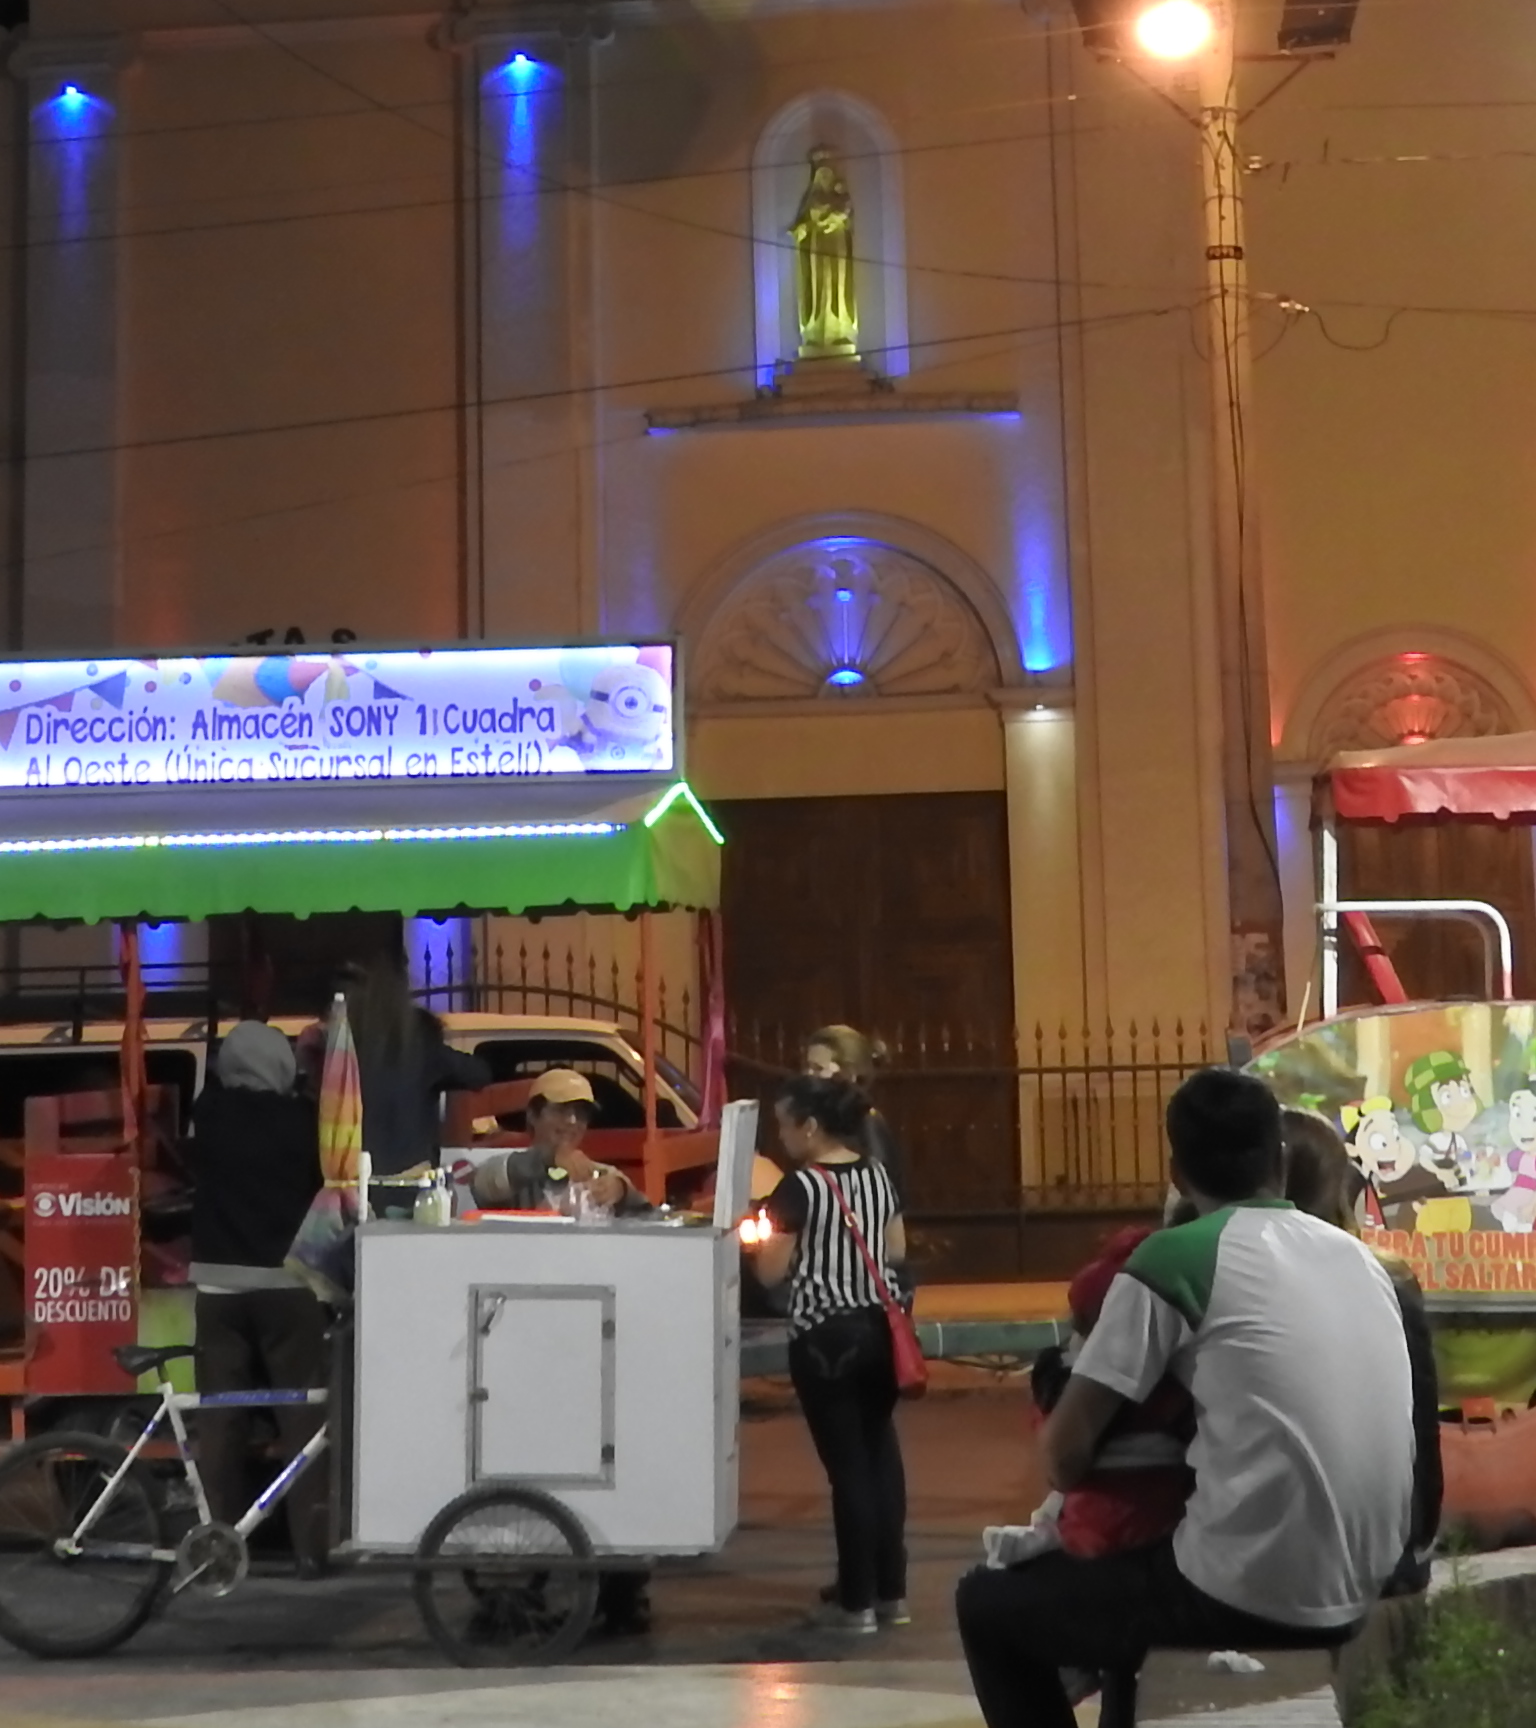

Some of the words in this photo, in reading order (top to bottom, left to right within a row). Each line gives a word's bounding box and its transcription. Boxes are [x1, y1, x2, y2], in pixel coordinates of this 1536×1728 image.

[26, 706, 176, 744] Dirección:
[192, 703, 313, 741] Almacén
[330, 704, 398, 737] SONY
[443, 697, 555, 735] Cuadra
[25, 754, 50, 787] Al
[64, 752, 151, 786] Oeste
[166, 745, 254, 783] (Única
[268, 746, 392, 781] Sucursal
[406, 753, 437, 778] en
[1361, 1229, 1428, 1259] EBRA
[1433, 1231, 1464, 1259] TU
[34, 1266, 91, 1299] 20%
[99, 1266, 132, 1297] DE
[34, 1300, 131, 1323] DESCUENTO
